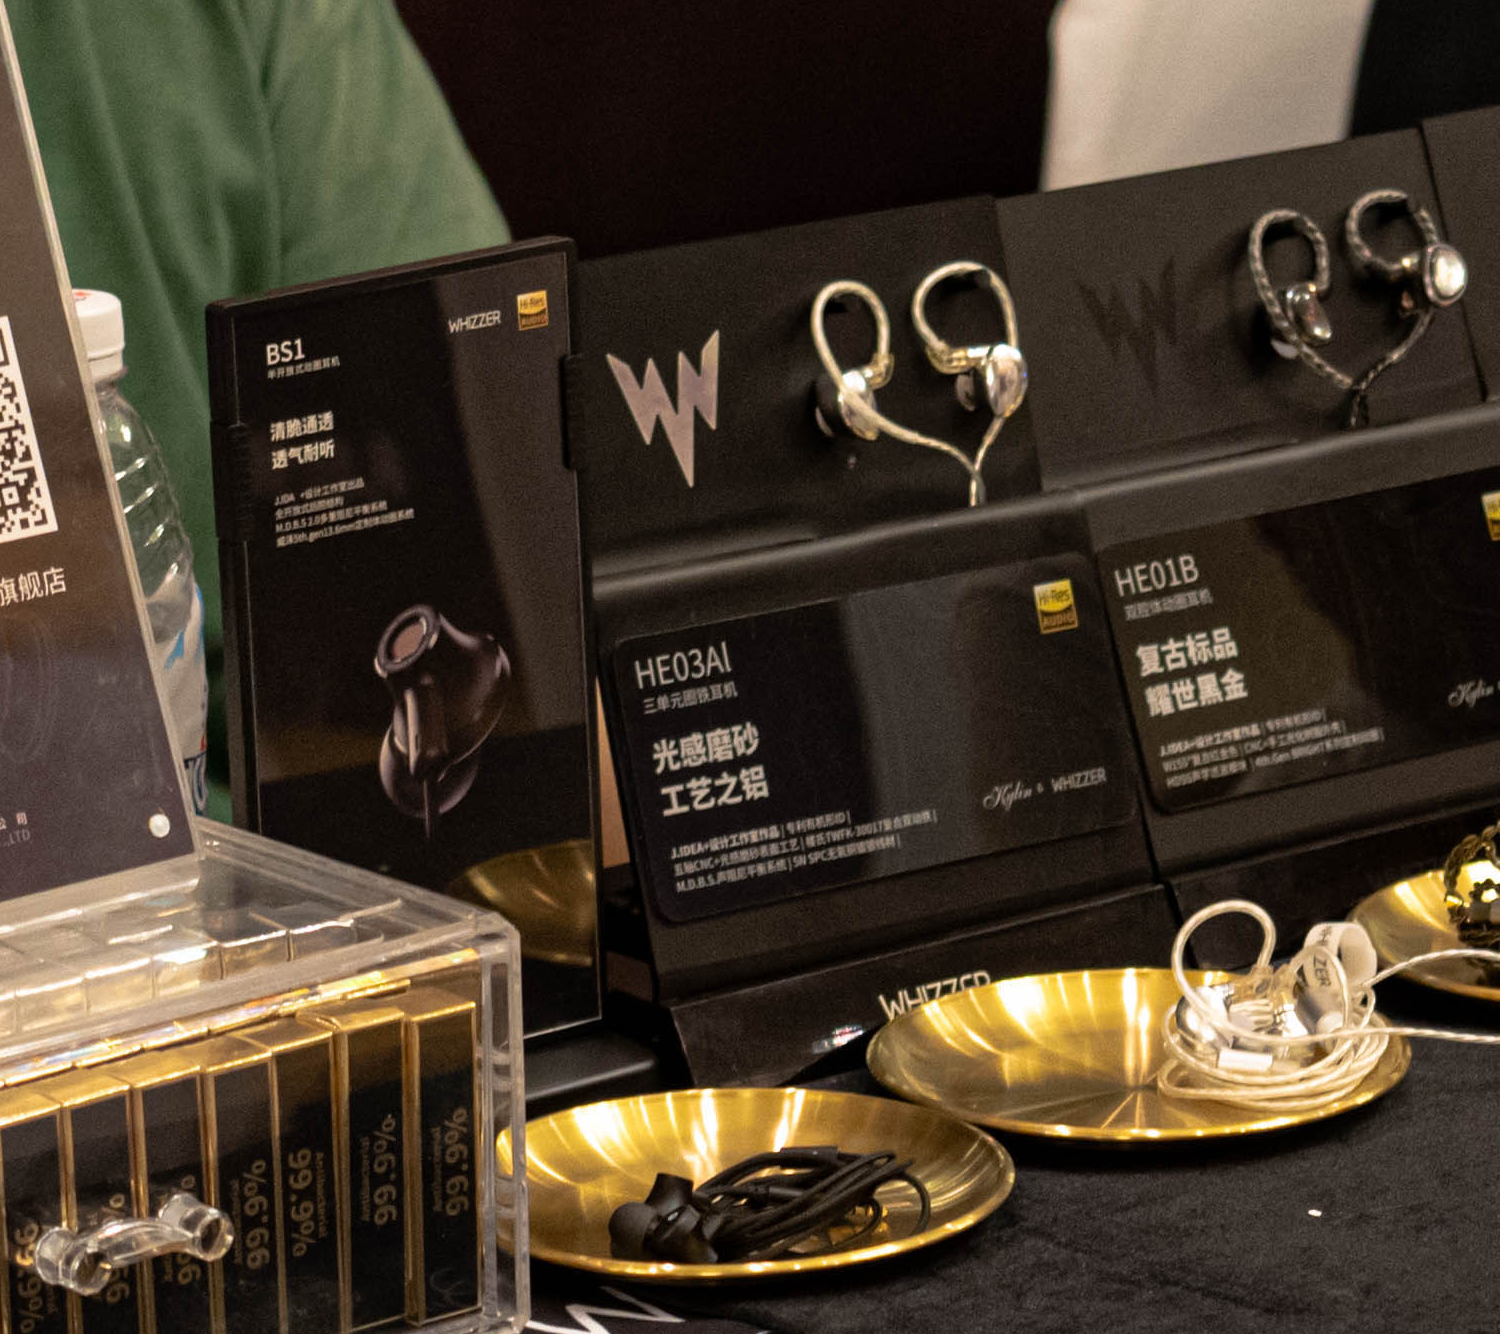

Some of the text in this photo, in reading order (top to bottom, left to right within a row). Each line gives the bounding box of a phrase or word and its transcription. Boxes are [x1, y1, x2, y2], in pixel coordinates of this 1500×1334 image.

[449, 309, 501, 333] WHIZZER
[266, 338, 306, 366] BS1
[271, 440, 335, 470] 透气耐听
[1036, 587, 1072, 607] Hi-Res
[1115, 554, 1200, 598] HE01B
[1136, 627, 1239, 678] 复古标品
[1145, 669, 1249, 719] 耀世黑金
[652, 722, 760, 774] 光感磨砂
[660, 765, 769, 816] 工艺之铝
[1051, 767, 1107, 794] WHIZZER
[373, 1113, 398, 1226] 99.9%
[444, 1107, 470, 1217] 99.9%
[244, 1159, 270, 1269] 99.9%
[289, 1148, 318, 1257] 99.9%
